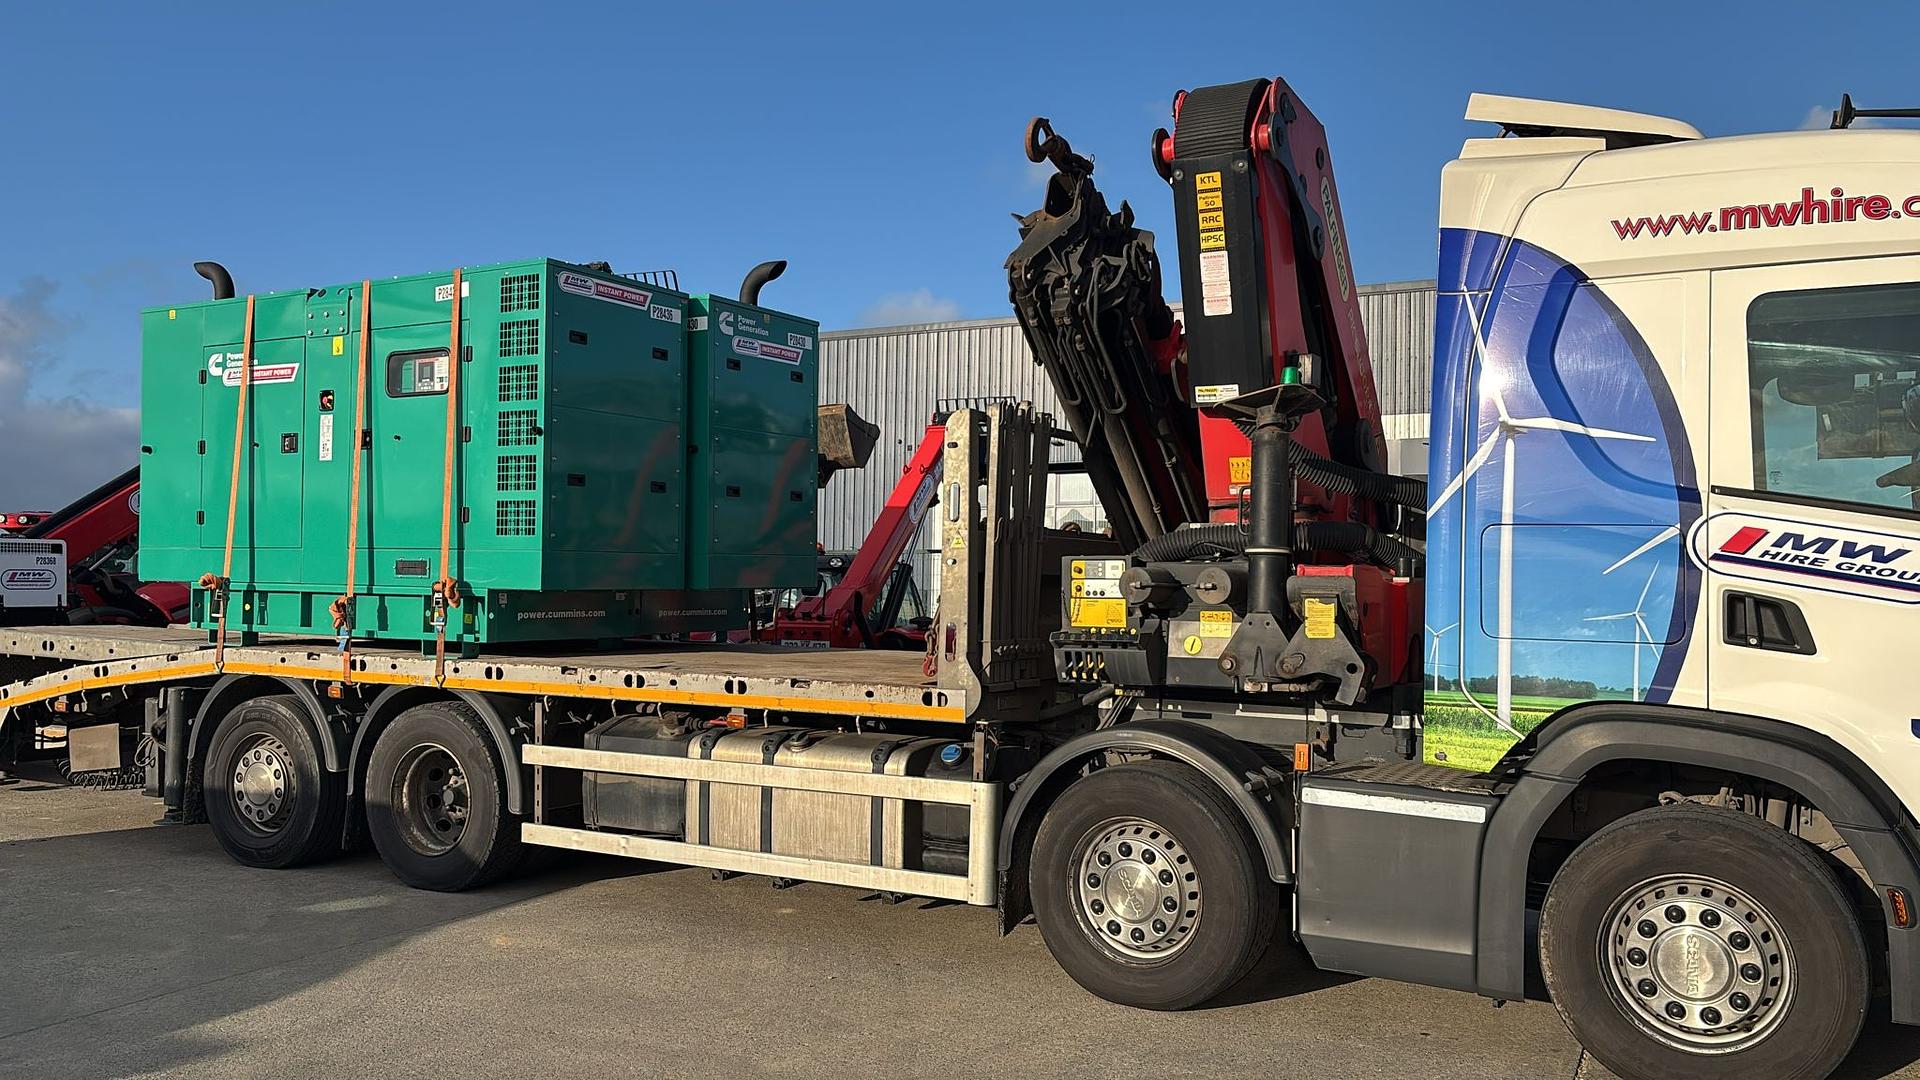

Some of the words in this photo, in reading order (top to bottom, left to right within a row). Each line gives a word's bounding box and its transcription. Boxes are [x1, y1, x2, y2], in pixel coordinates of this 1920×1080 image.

[1200, 176, 1217, 184] KTL
[1202, 215, 1221, 224] RRC
[1201, 234, 1223, 243] HPSC
[1322, 184, 1347, 296] PALFINGER
[597, 284, 623, 297] INSTANT
[623, 291, 644, 303] POWER
[738, 315, 756, 325] Power
[738, 323, 769, 336] Generation
[762, 346, 780, 355] INSTANT
[781, 350, 797, 358] POWER
[273, 368, 292, 376] POWER
[1770, 532, 1913, 564] MW
[1758, 550, 1829, 568] HIRE
[517, 610, 606, 621] power.cummins.com
[658, 608, 728, 618] power.cummins.com
